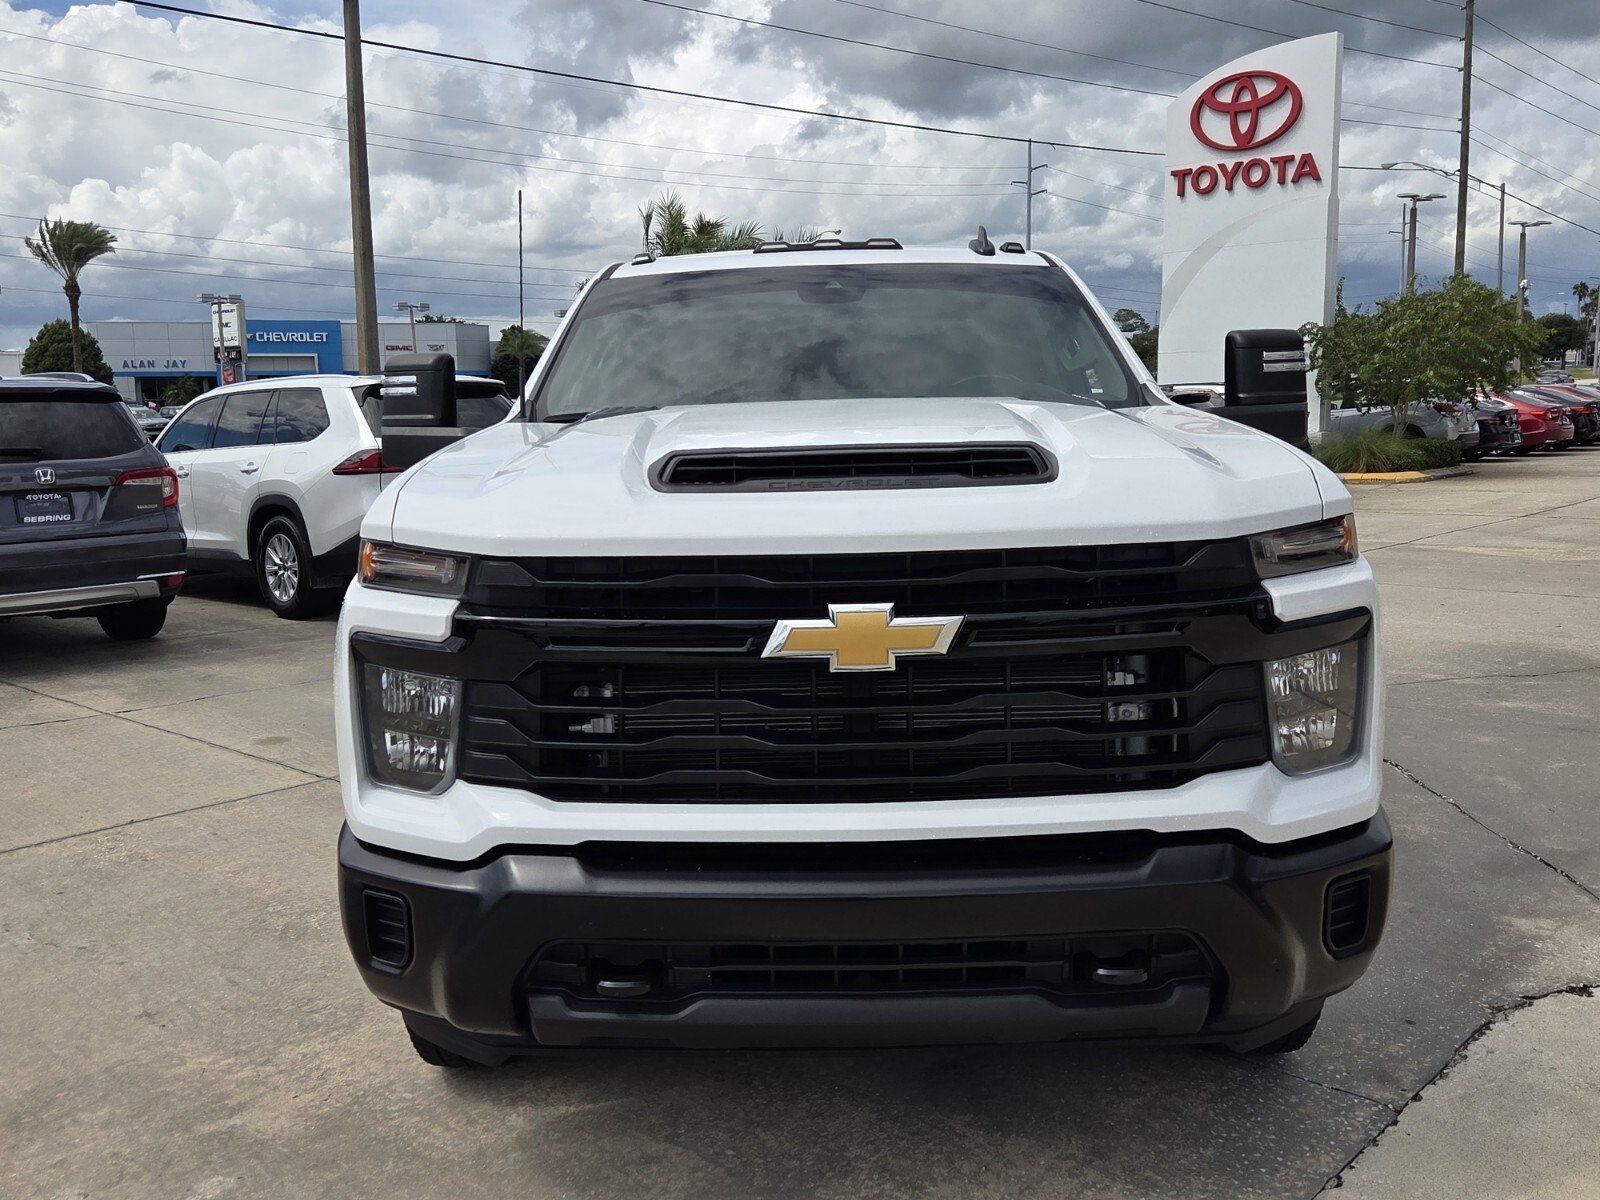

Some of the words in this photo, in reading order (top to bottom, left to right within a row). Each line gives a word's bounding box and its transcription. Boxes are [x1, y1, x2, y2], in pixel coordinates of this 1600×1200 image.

[1170, 152, 1322, 197] TOYOTA
[214, 335, 238, 343] CAILLAC
[255, 331, 329, 342] CHEVROLET
[122, 359, 155, 369] ALAN
[163, 359, 187, 369] JAY
[768, 477, 941, 490] CHEVROLET
[23, 514, 71, 523] SEBRING
